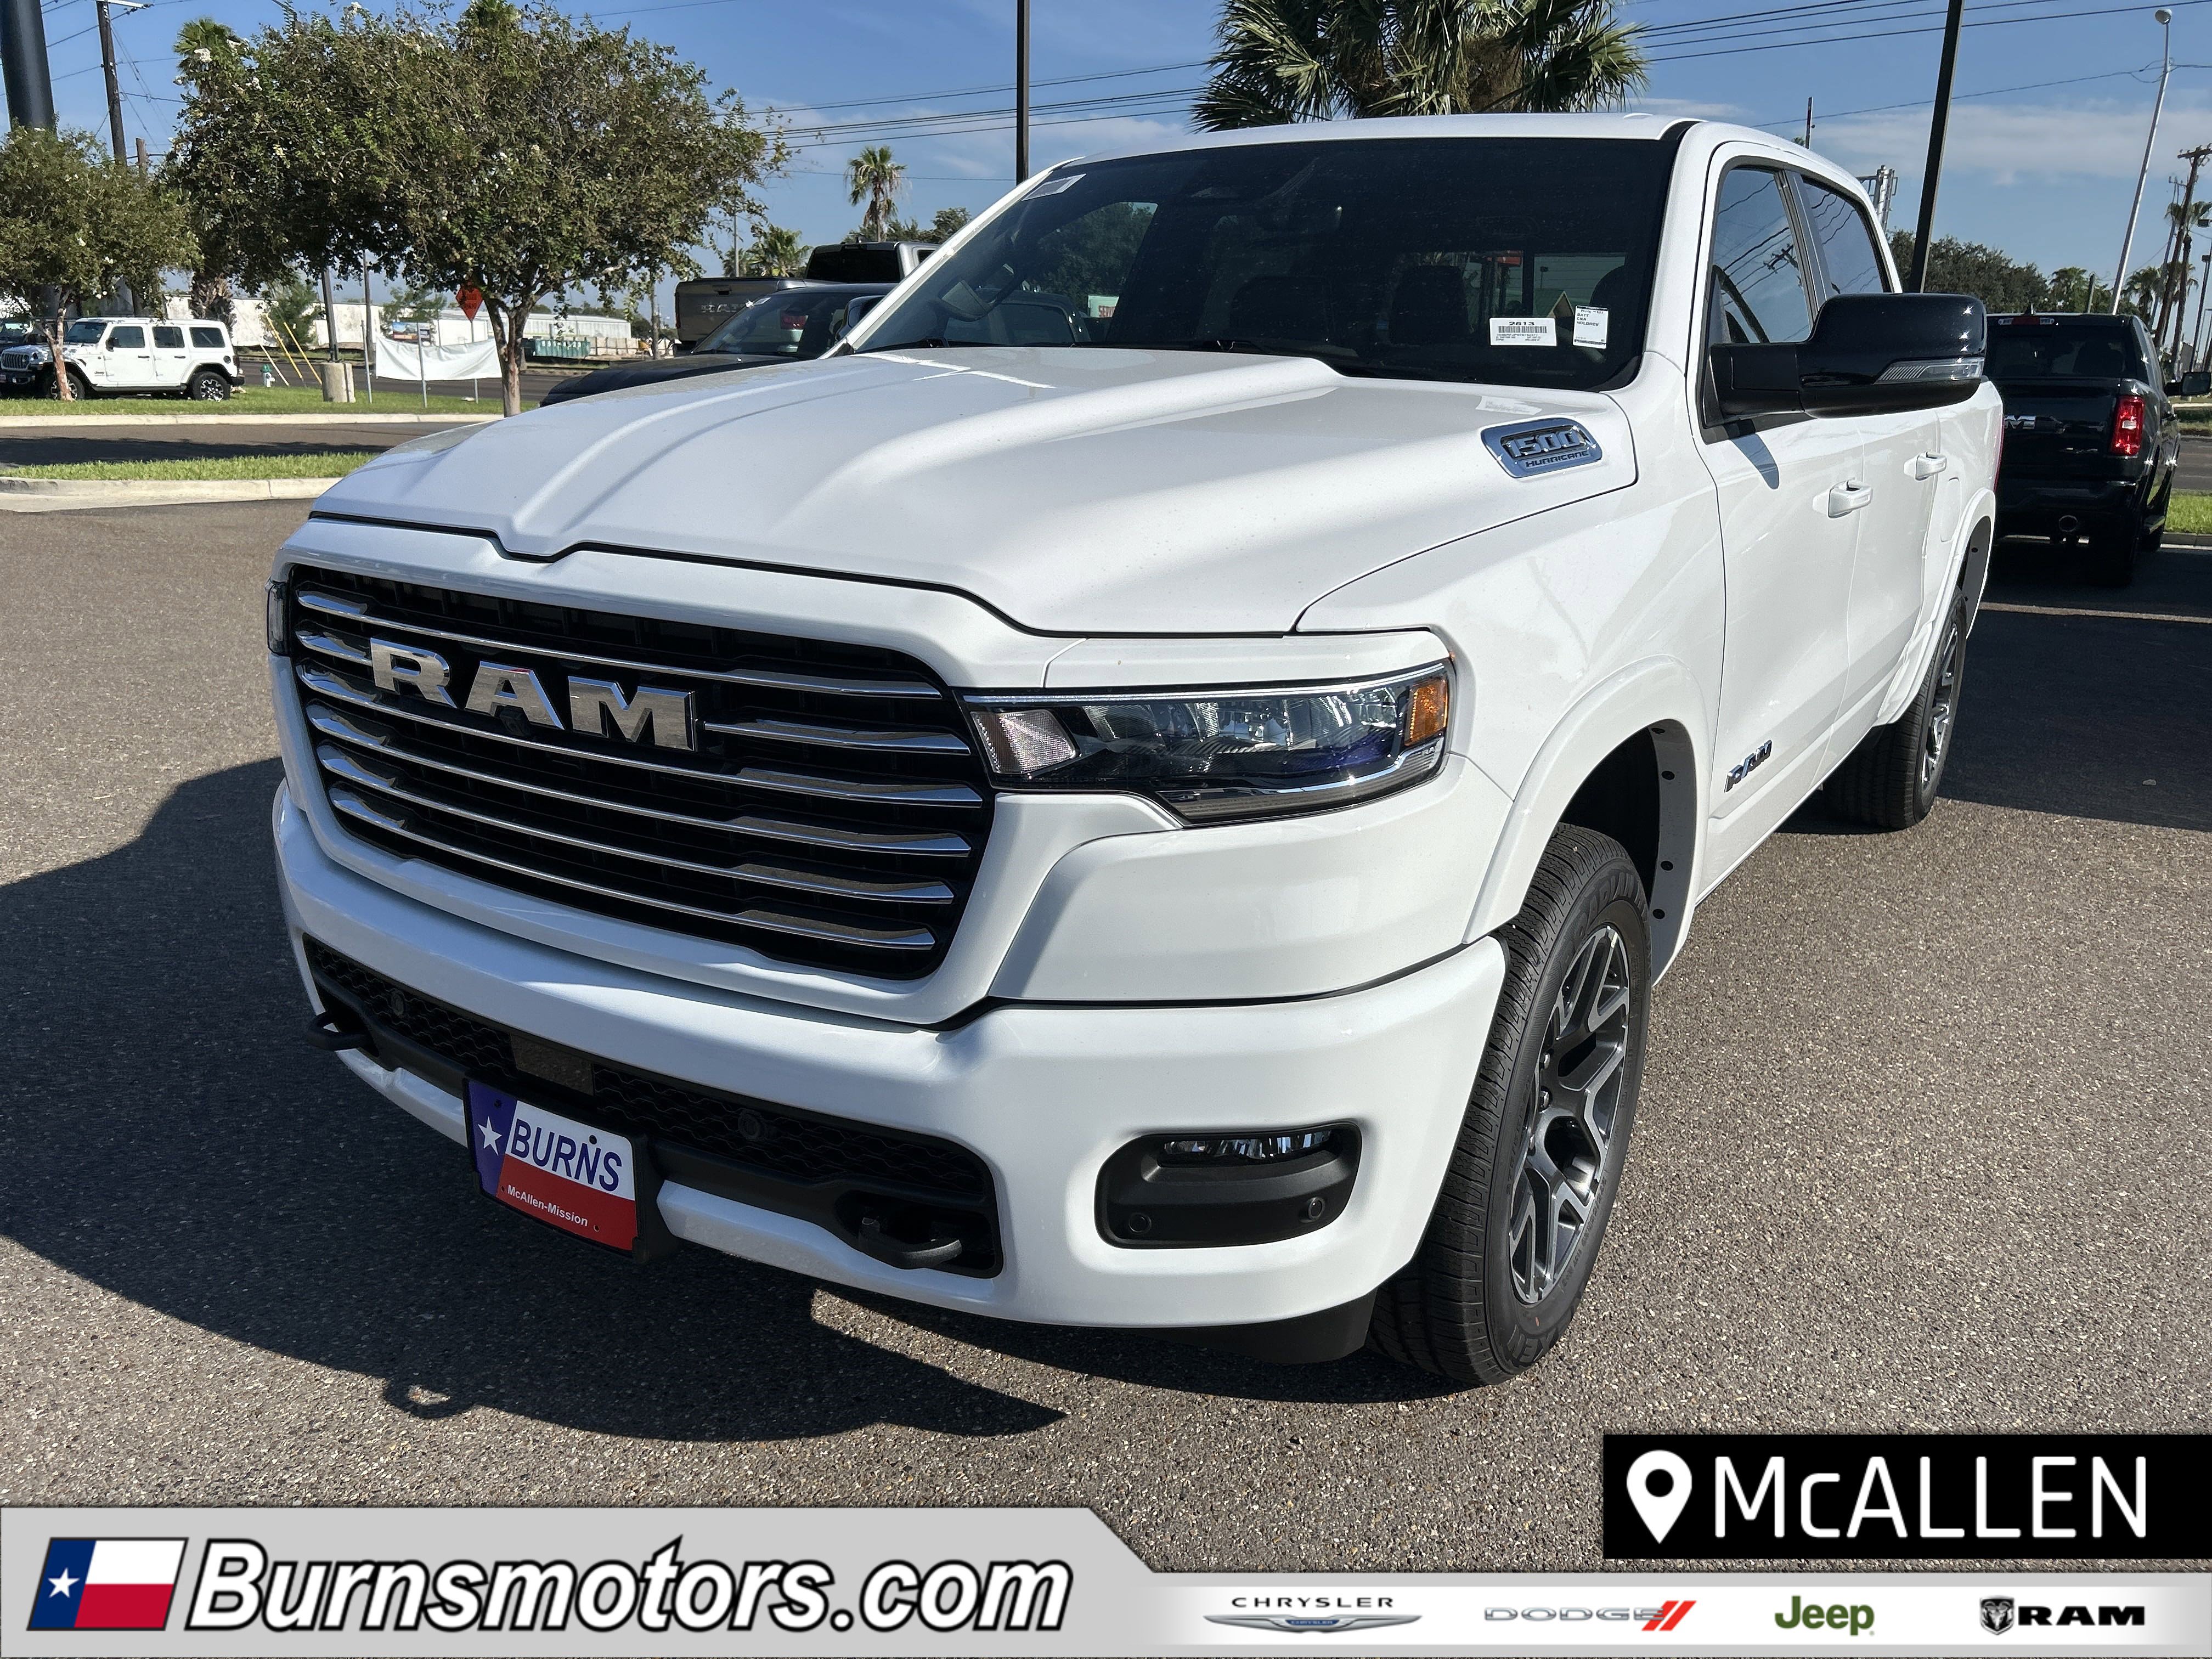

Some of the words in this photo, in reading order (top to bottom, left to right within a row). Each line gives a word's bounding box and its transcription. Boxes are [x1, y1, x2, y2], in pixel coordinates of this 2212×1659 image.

[1502, 428, 1585, 458] 1500
[1525, 450, 1589, 468] HURRICANE
[370, 637, 696, 752] RAM
[511, 1118, 622, 1192] BURNS
[507, 1184, 588, 1227] McAllen-Mission
